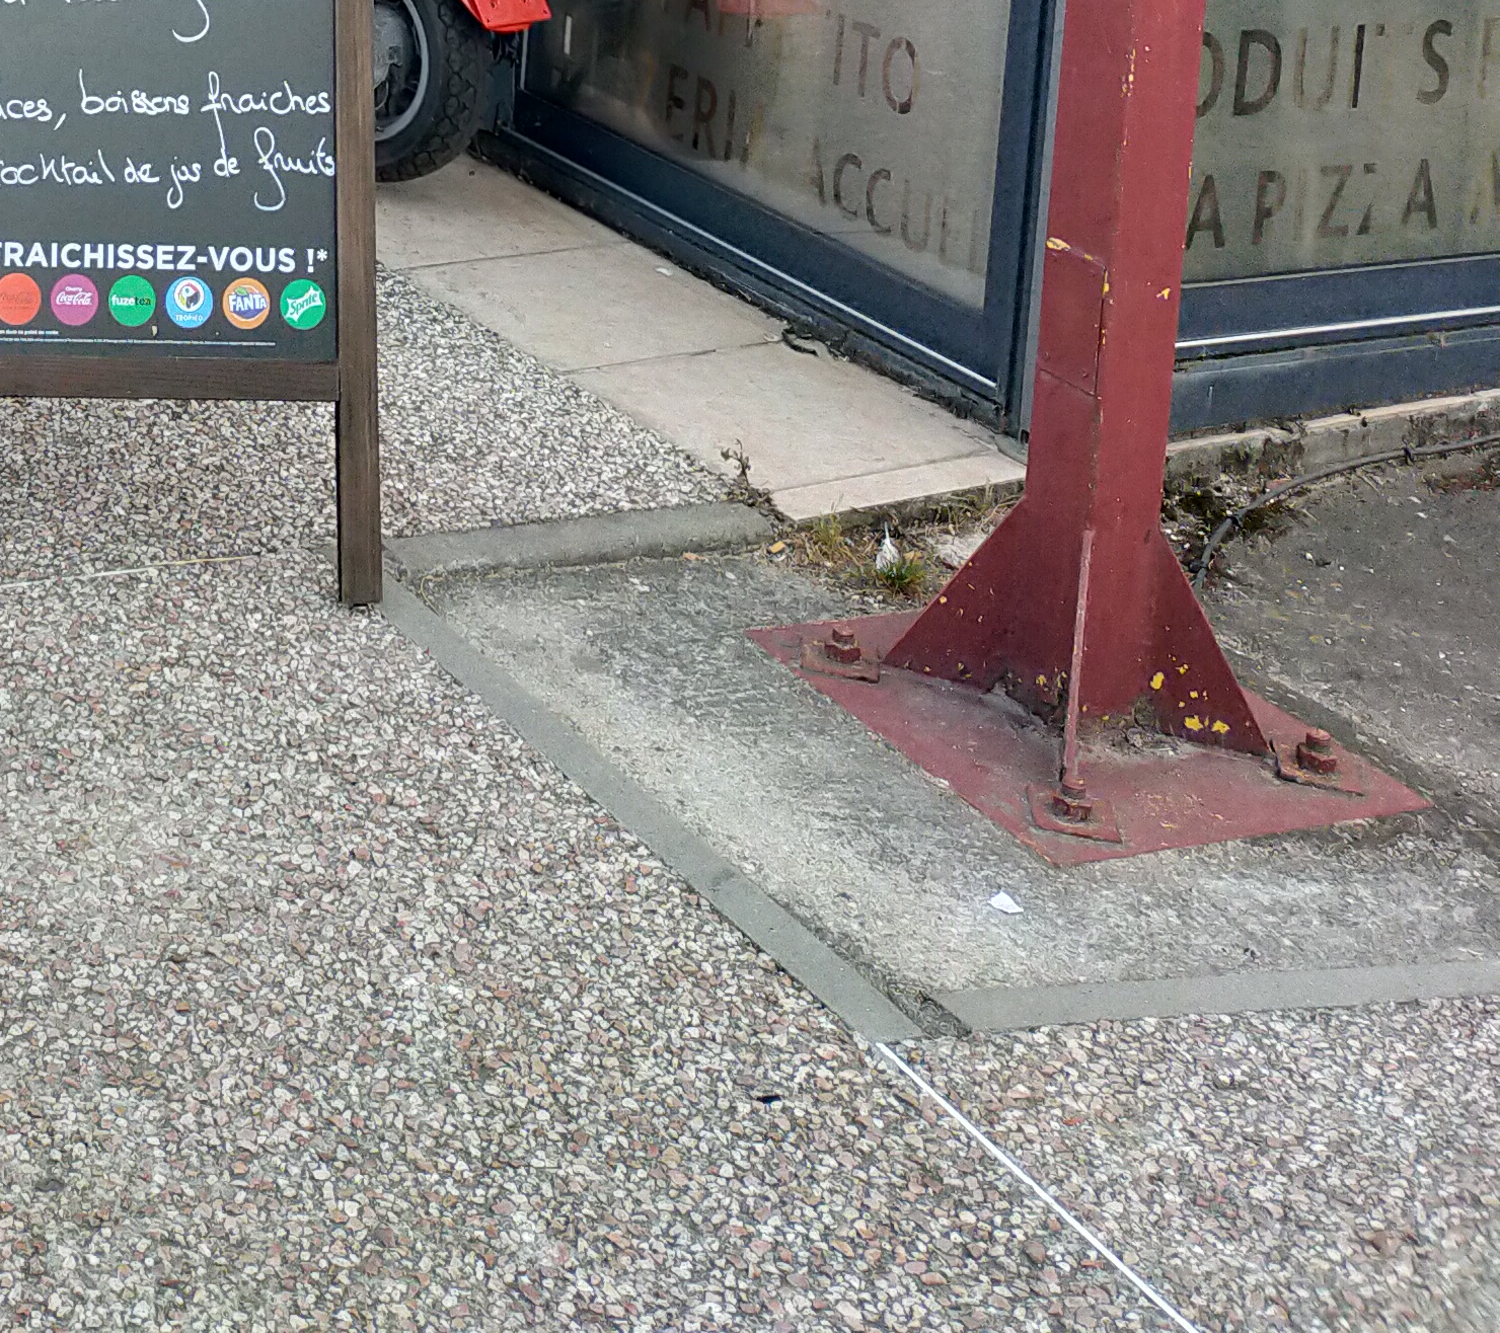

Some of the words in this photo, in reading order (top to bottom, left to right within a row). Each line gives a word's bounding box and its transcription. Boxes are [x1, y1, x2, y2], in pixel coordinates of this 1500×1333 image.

[79, 68, 190, 116] boissons
[200, 71, 332, 133] fraiches
[123, 157, 161, 185] de
[167, 156, 202, 209] jus
[214, 147, 240, 178] de
[253, 127, 335, 211] fruits
[228, 294, 268, 312] FANTA
[289, 290, 319, 316] Sprite
